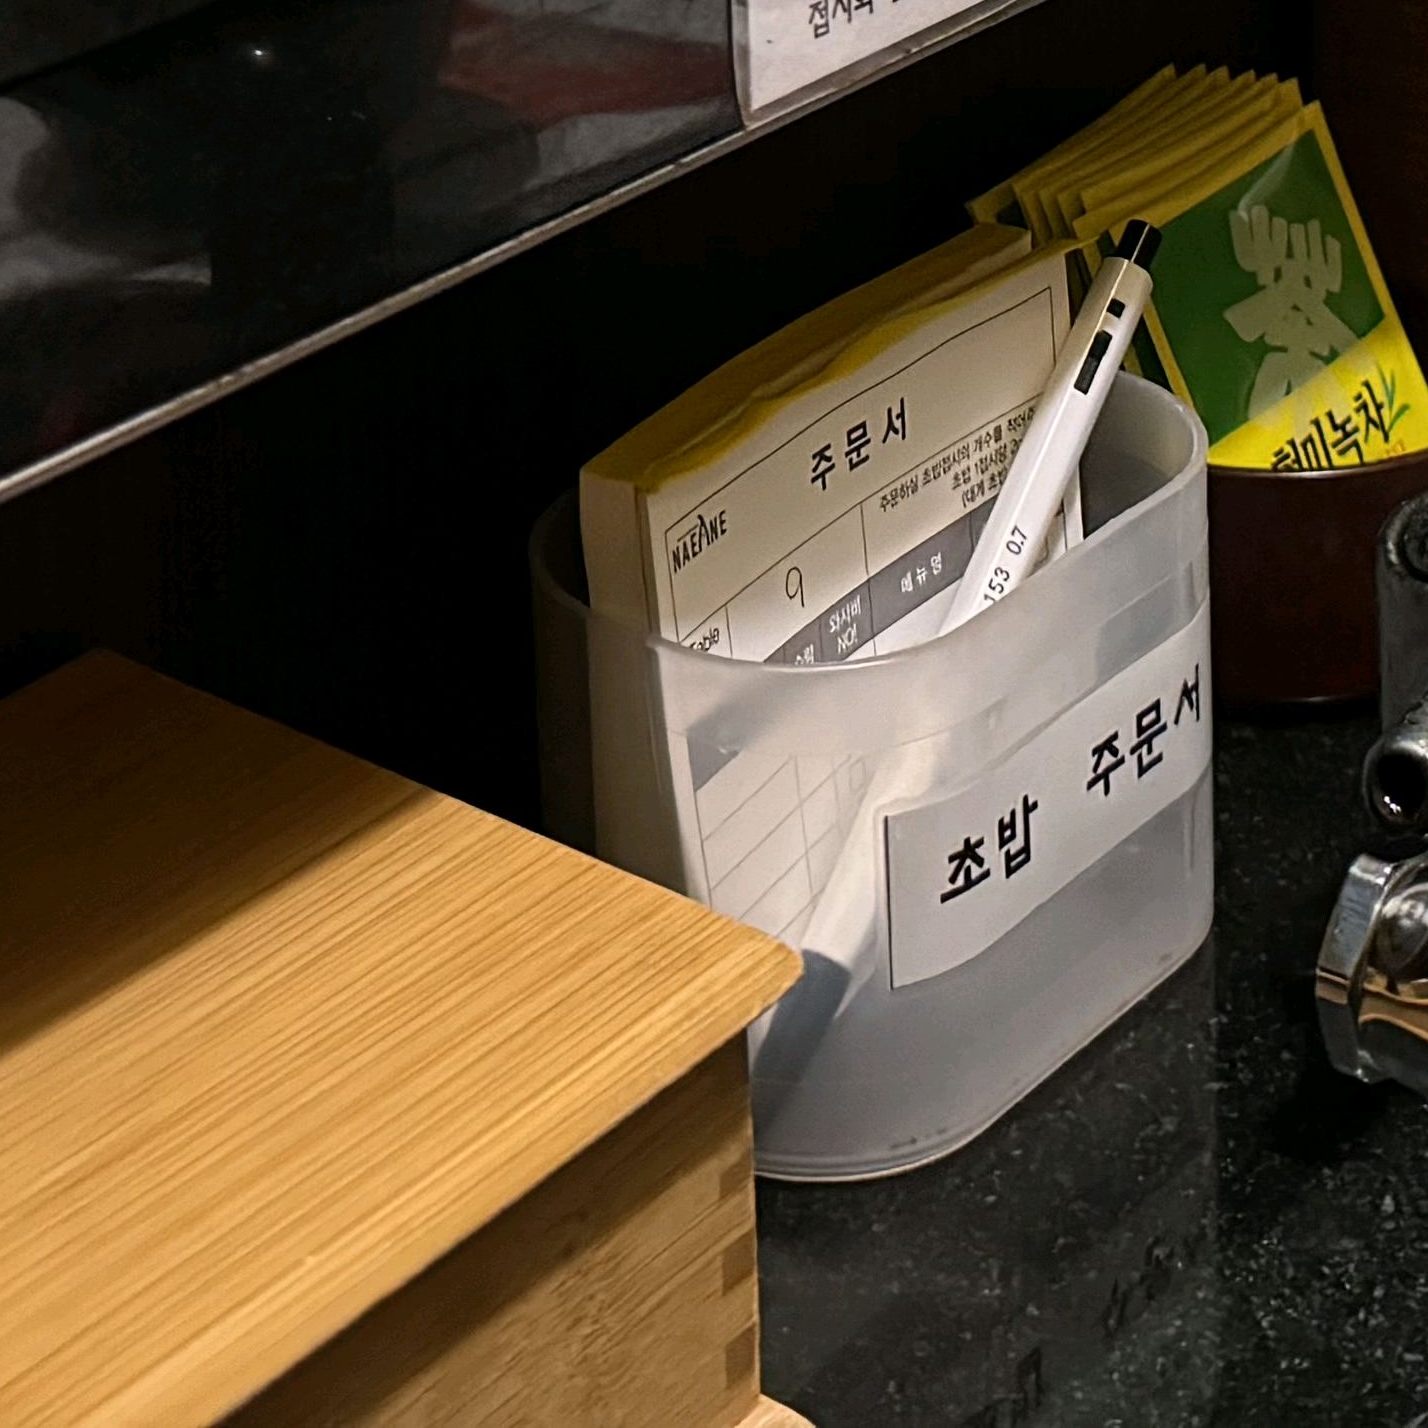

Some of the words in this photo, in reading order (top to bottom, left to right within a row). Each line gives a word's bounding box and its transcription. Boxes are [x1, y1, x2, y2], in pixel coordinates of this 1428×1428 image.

[808, 396, 908, 492] 주문서
[879, 474, 920, 513] 주문하실
[785, 566, 806, 608] 9
[983, 565, 1010, 605] 153
[1006, 525, 1028, 555] 0.7
[939, 794, 1039, 904] 초밥
[1086, 663, 1200, 797] 주문서
